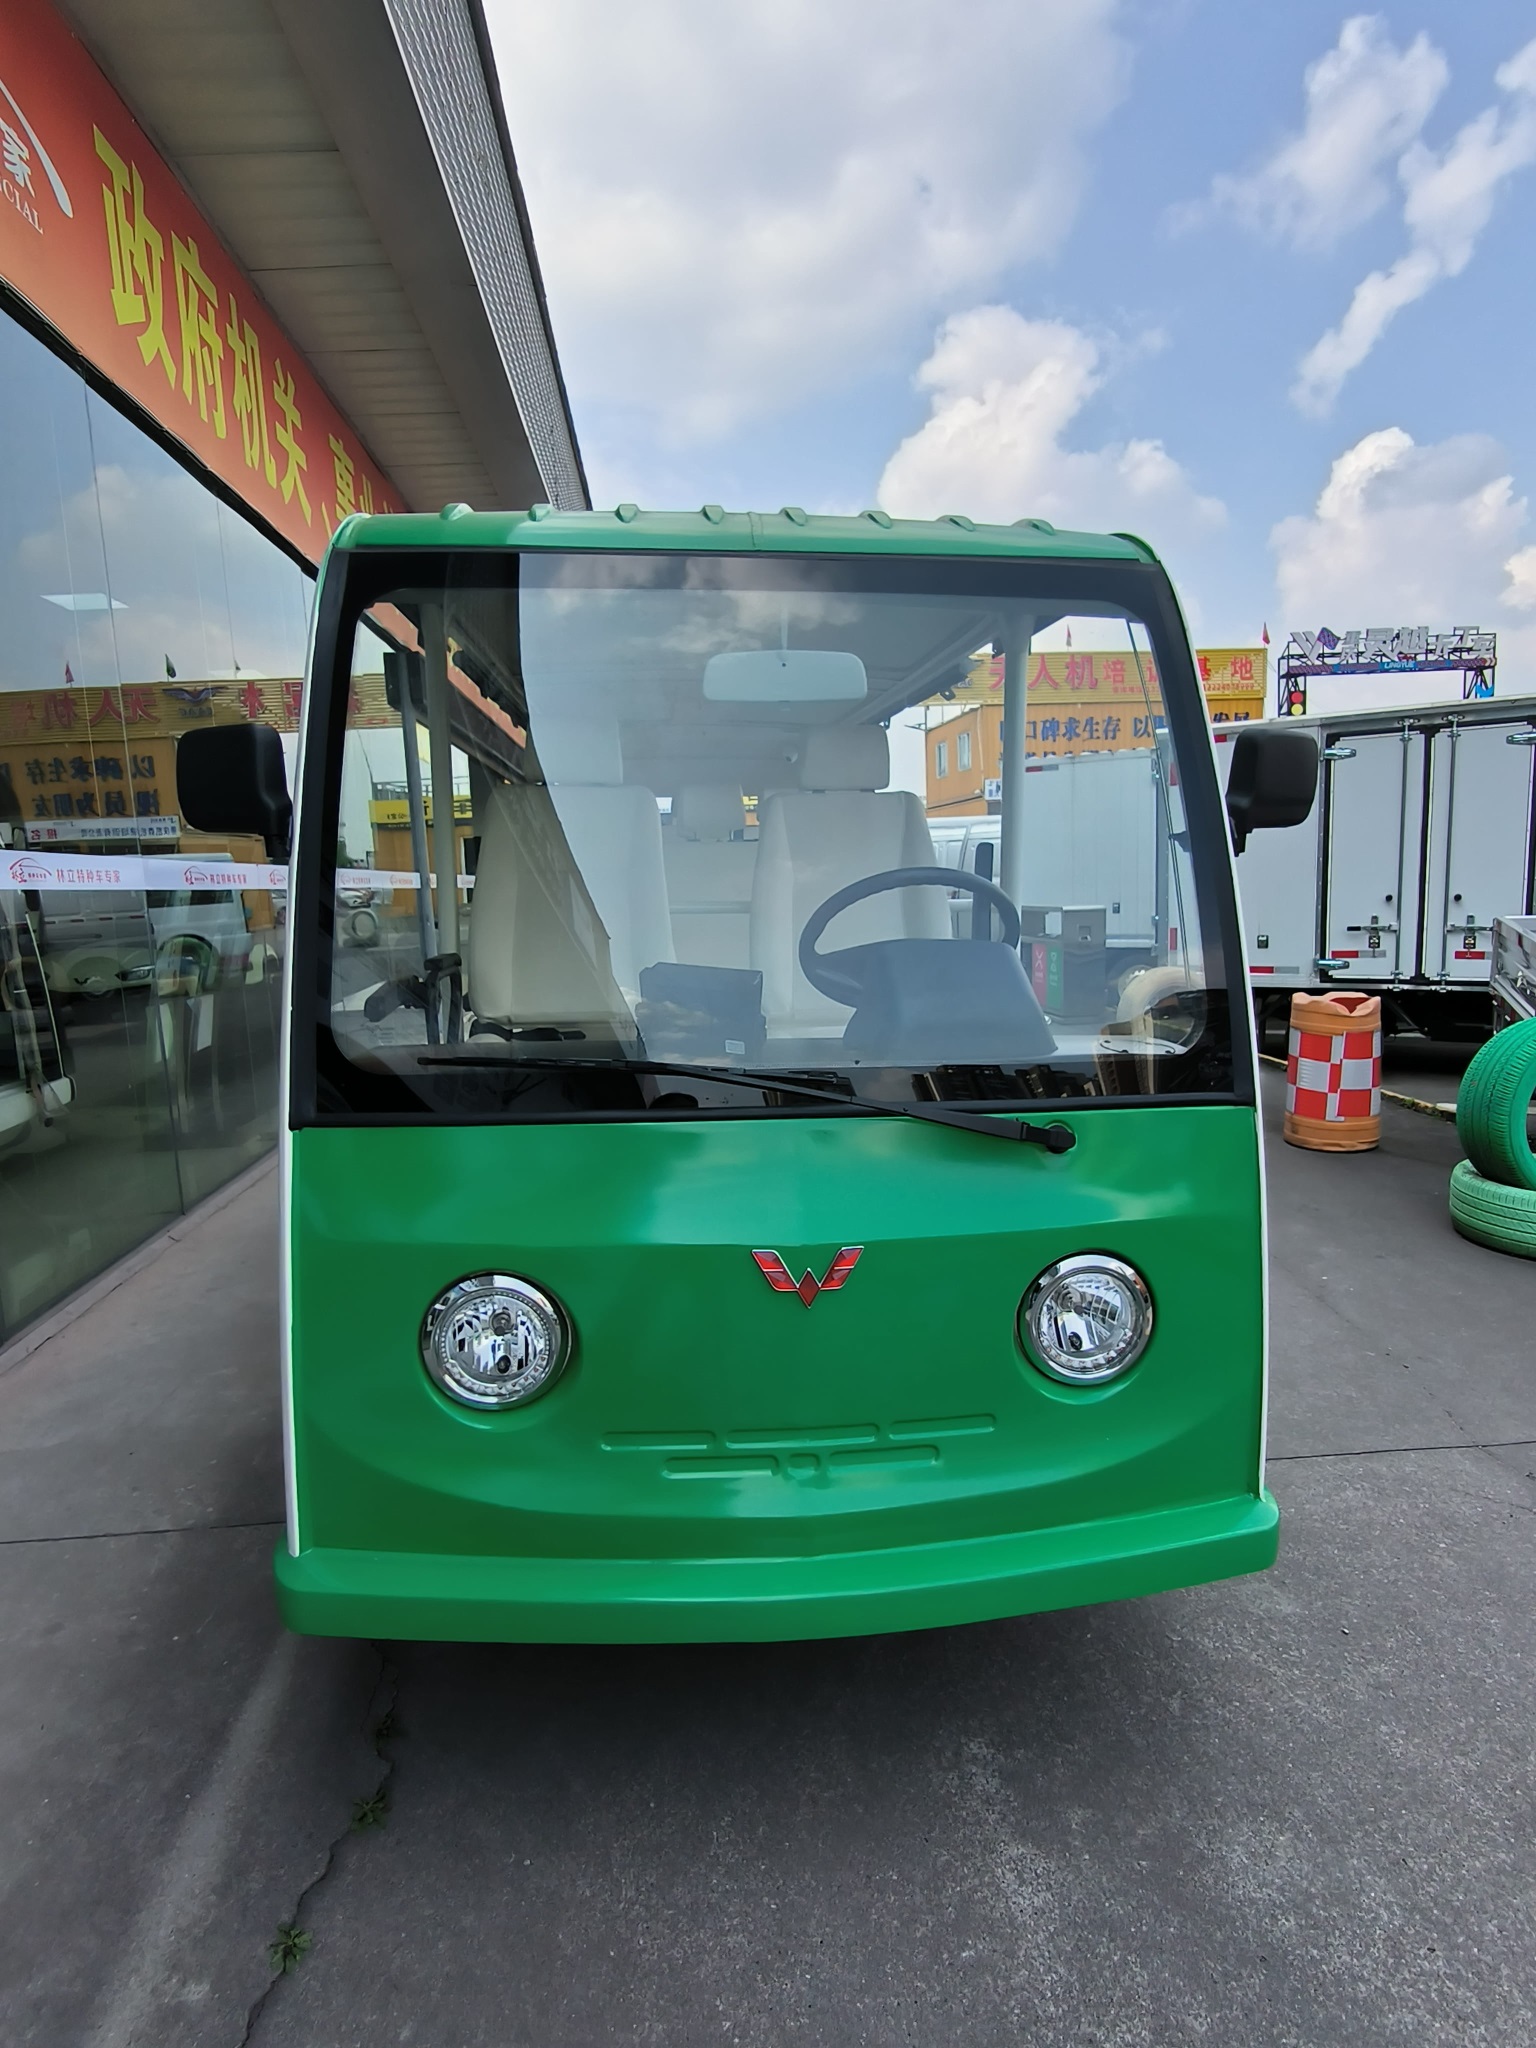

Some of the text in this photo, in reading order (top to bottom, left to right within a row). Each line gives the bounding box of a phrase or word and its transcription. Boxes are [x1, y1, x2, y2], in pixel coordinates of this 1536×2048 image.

[0, 175, 44, 235] CIAL
[999, 715, 1121, 742] 口碑求生存
[56, 868, 122, 884] 林立特种车专家
